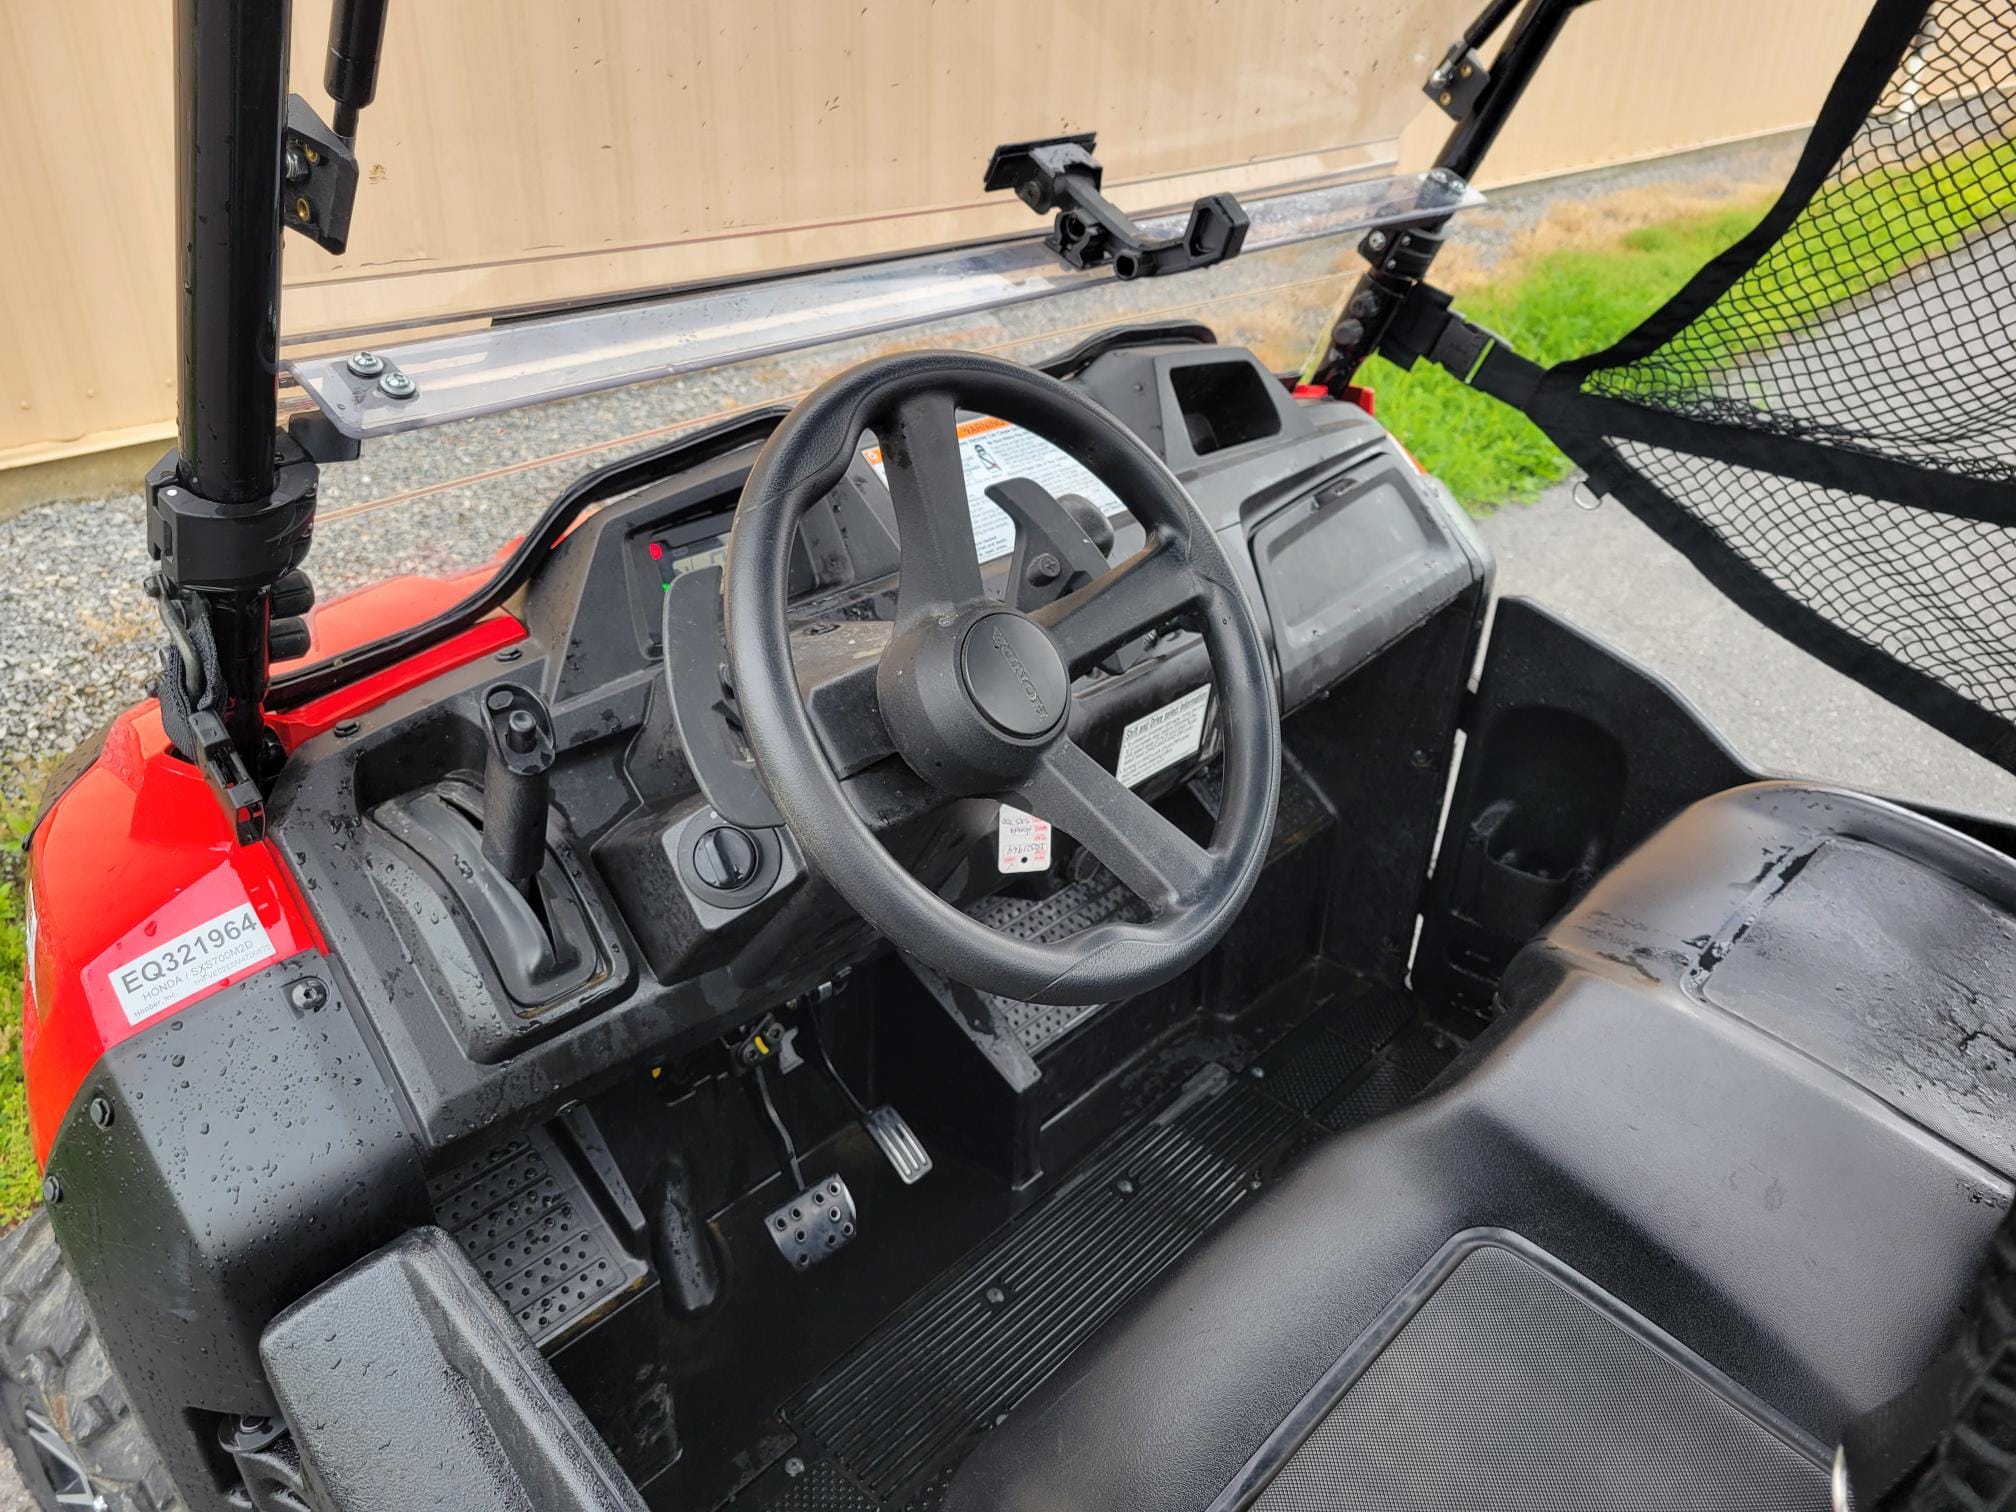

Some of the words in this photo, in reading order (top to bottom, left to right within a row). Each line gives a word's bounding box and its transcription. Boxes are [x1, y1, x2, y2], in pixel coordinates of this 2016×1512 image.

[992, 625, 1048, 722] HONDA
[121, 912, 258, 994] EQ321964
[143, 976, 184, 1001] HONDA
[191, 940, 254, 977] SXS700M2D
